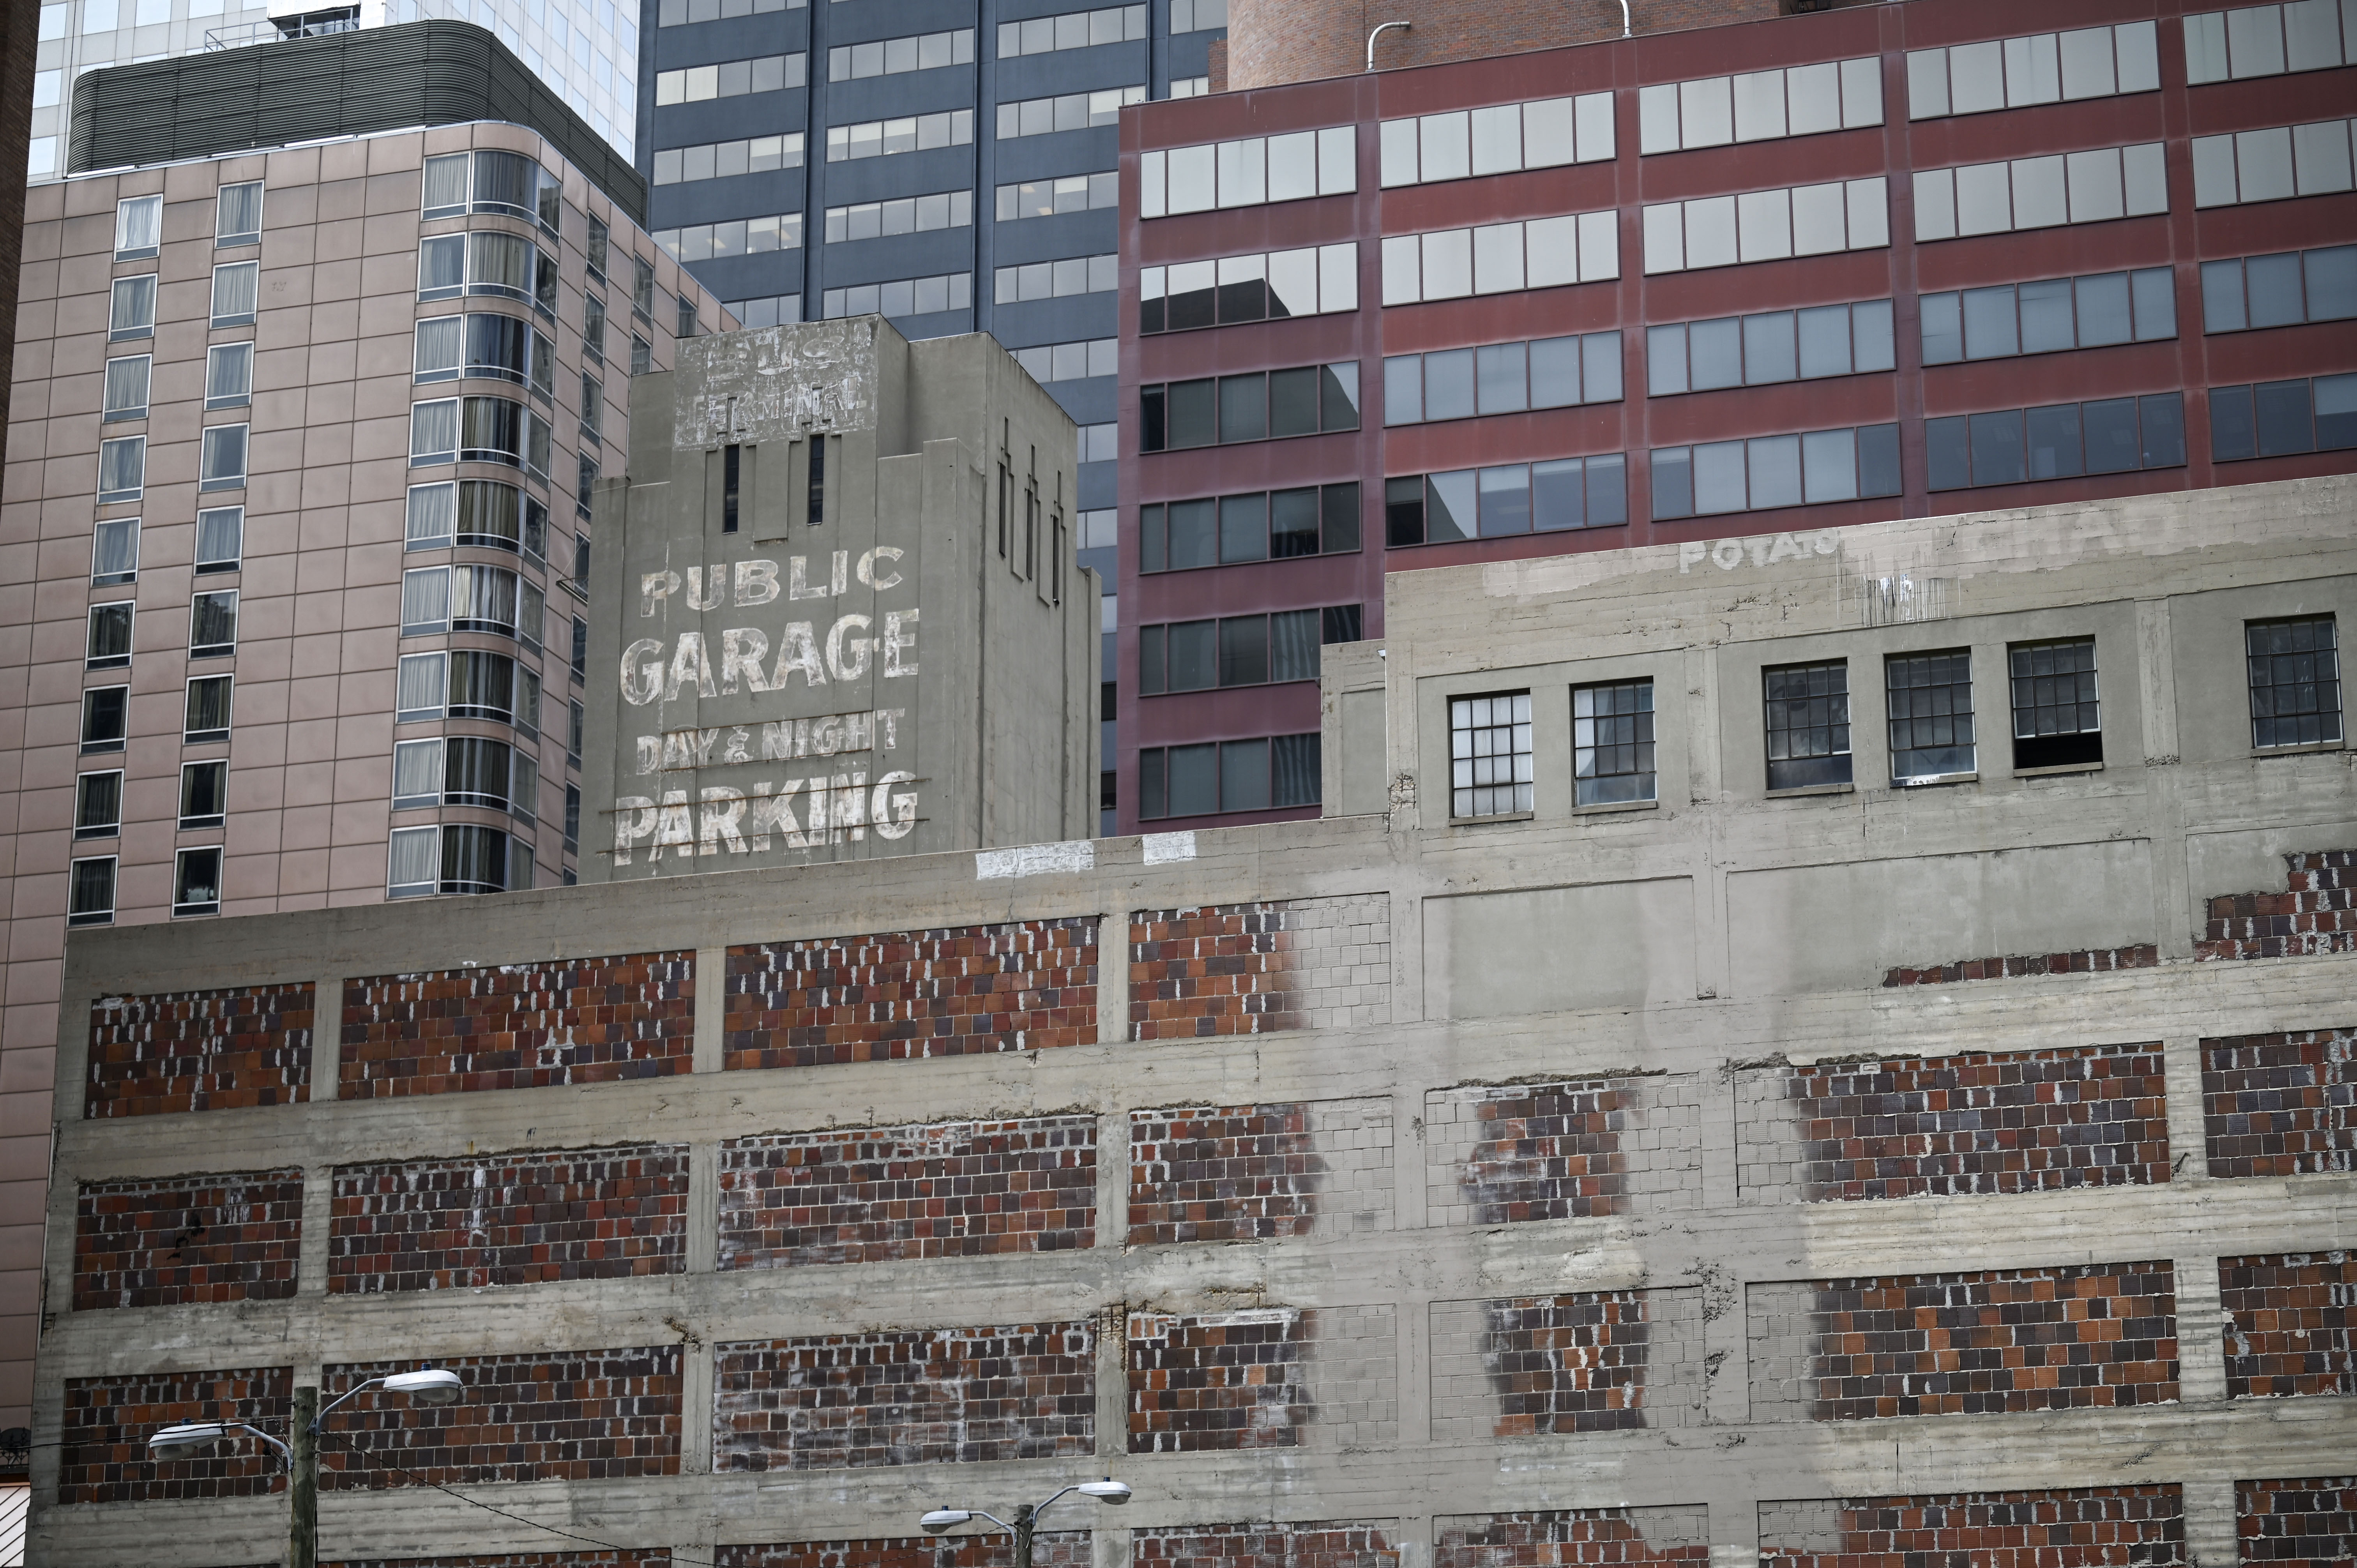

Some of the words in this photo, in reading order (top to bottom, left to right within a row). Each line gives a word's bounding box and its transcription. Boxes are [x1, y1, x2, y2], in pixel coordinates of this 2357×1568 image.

[706, 335, 845, 383] BUS
[641, 546, 905, 618] PUBLIC
[620, 608, 919, 706] GARAGE
[636, 727, 719, 775] DAY
[724, 725, 753, 764] &
[762, 708, 905, 761] NIGHT
[614, 770, 918, 866] PARKING
